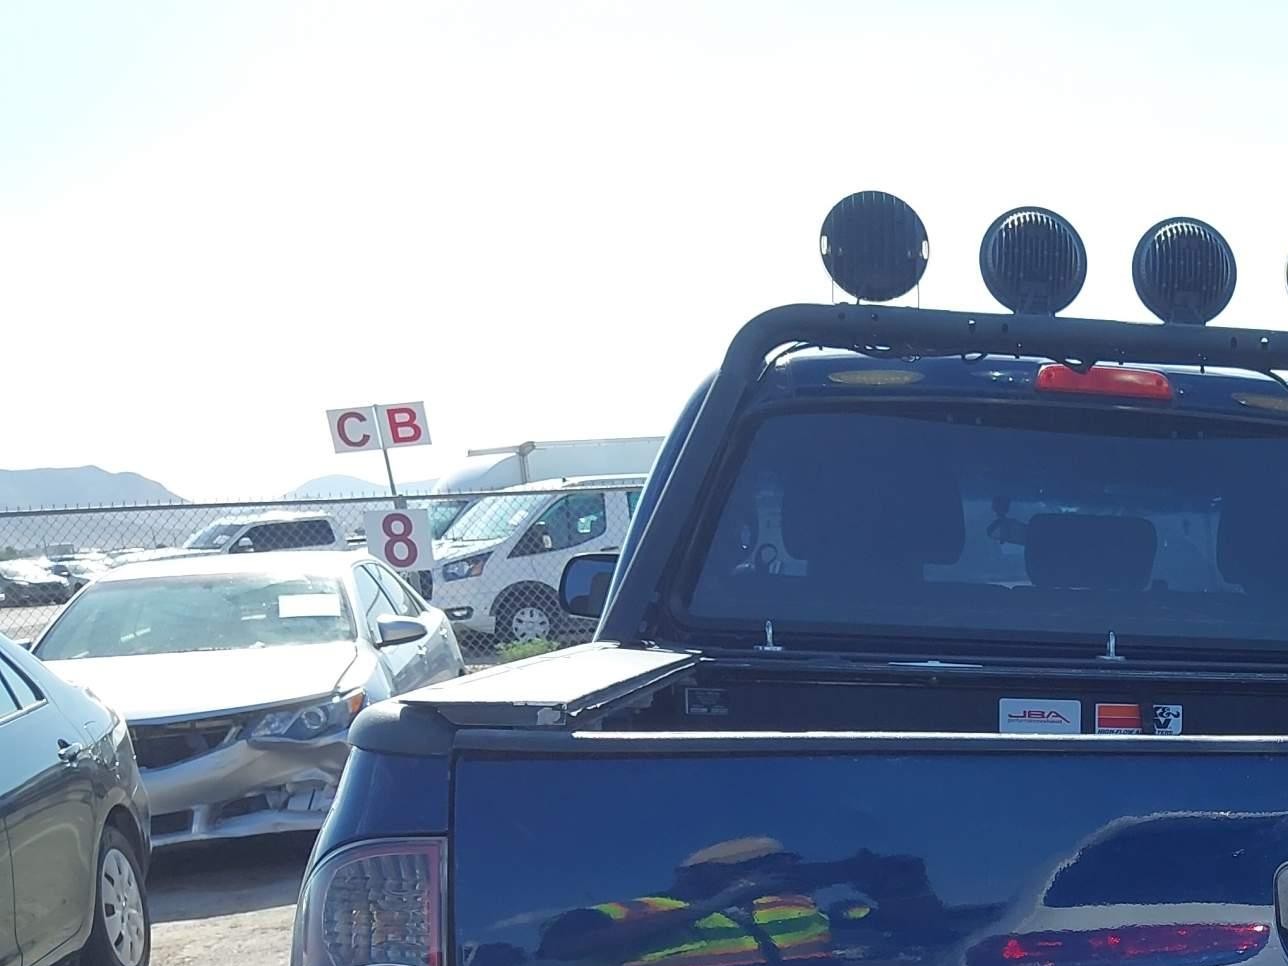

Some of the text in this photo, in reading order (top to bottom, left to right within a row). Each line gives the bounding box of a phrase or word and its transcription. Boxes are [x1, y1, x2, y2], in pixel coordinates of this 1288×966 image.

[336, 407, 422, 448] C B
[382, 512, 418, 568] 8
[1008, 710, 1070, 723] JBA
